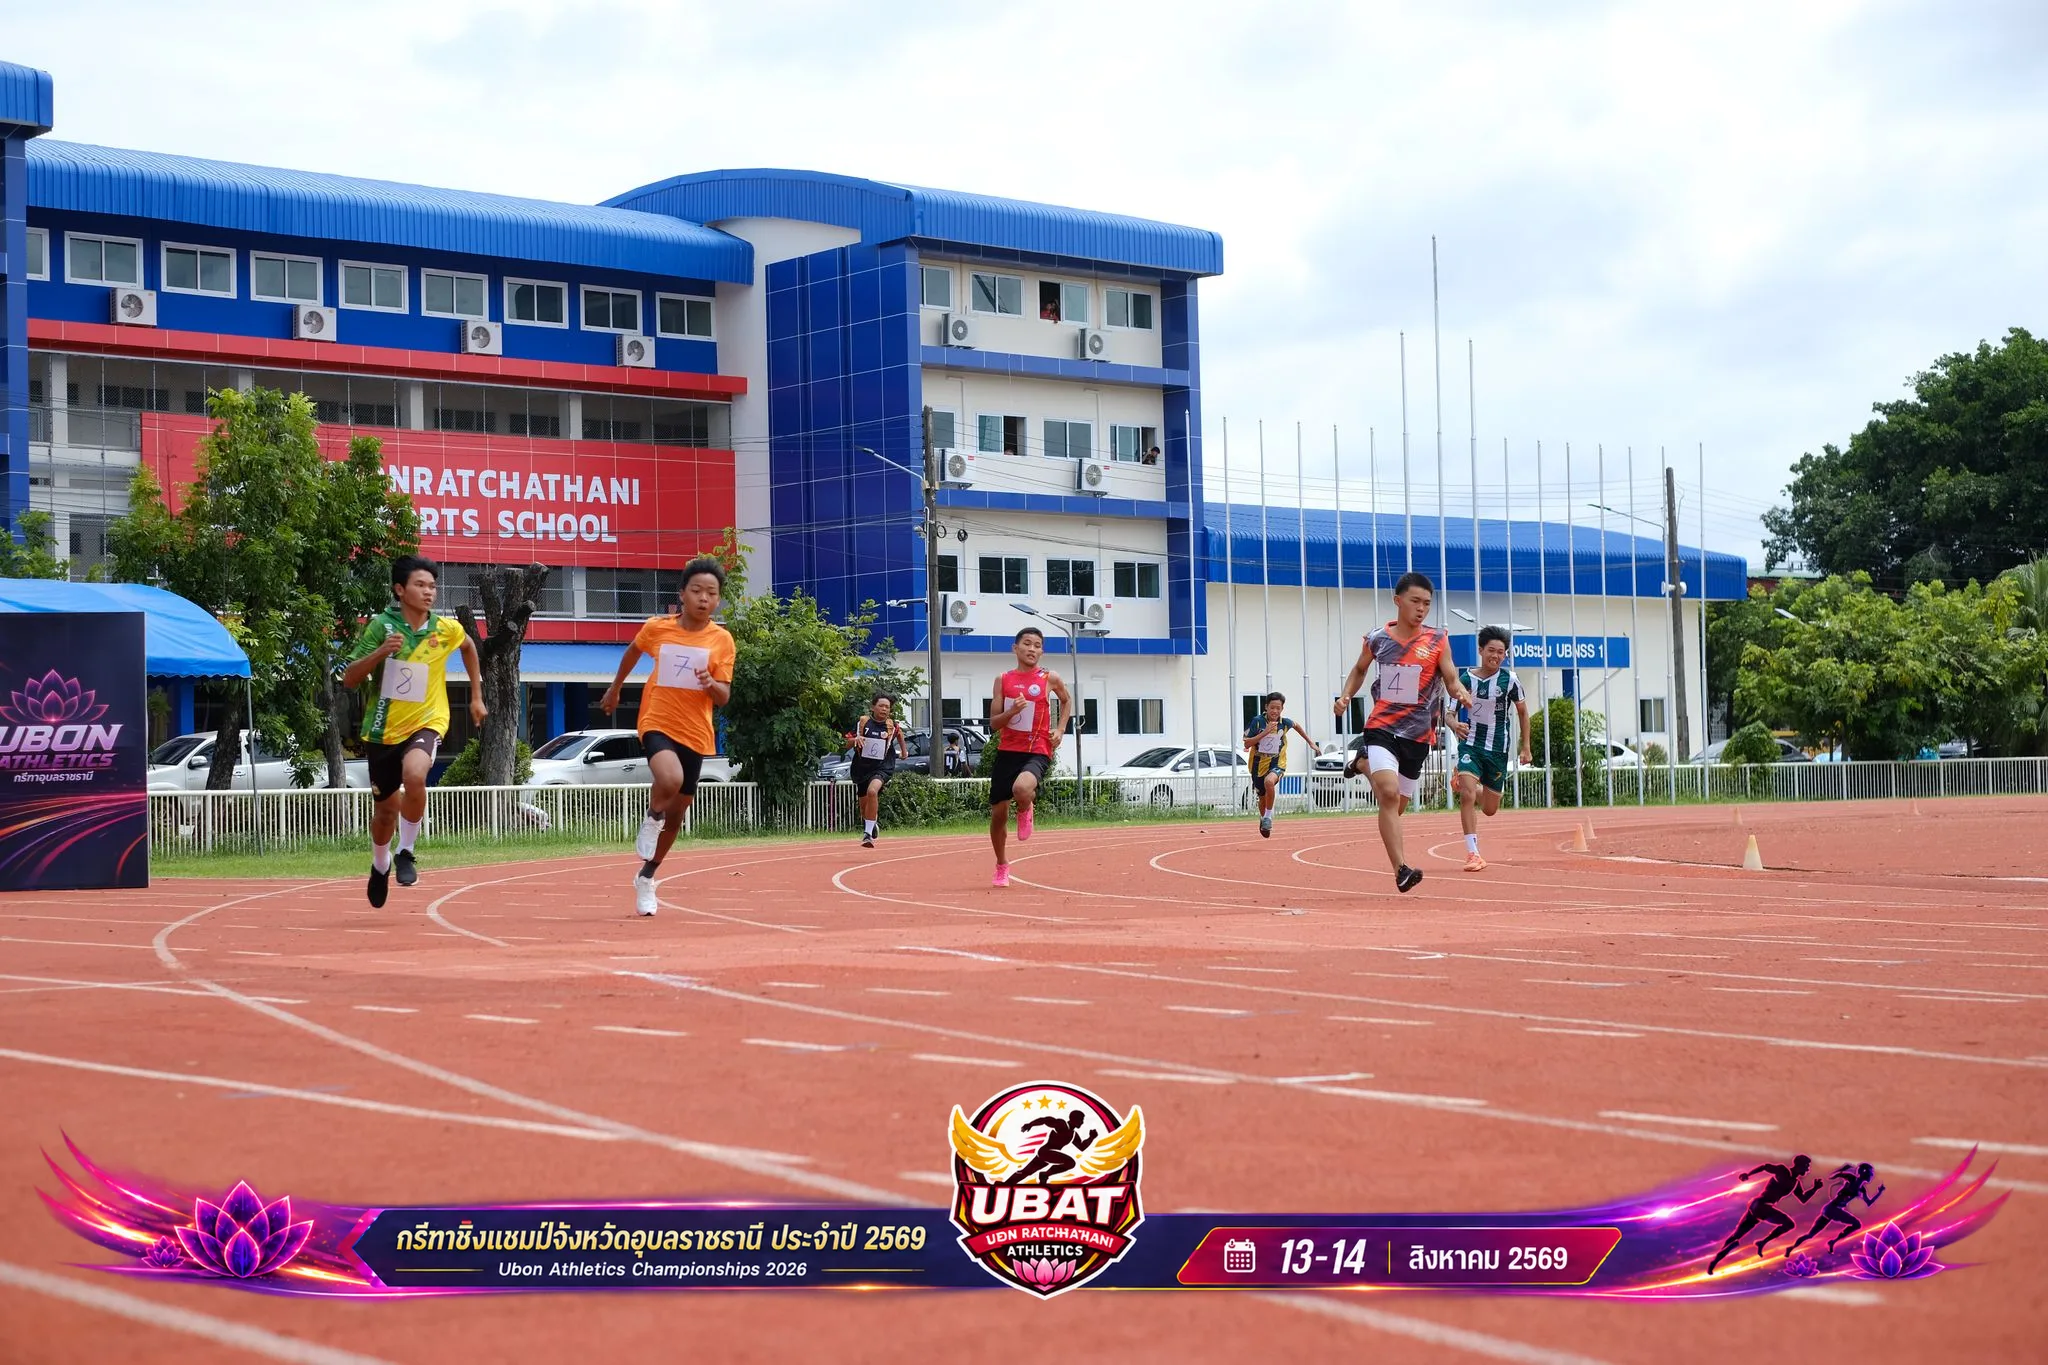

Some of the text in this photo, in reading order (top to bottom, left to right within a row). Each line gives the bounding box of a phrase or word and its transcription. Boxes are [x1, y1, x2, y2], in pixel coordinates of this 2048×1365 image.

[377, 464, 640, 505] NRATCHATHANI
[498, 510, 617, 543] SCHOOL
[674, 654, 693, 677] 7
[396, 667, 413, 694] 8
[1387, 672, 1404, 695] 4
[1472, 702, 1483, 717] 2
[0, 724, 124, 753] UBON
[864, 727, 870, 735] 7
[0, 753, 119, 769] ATHLETICS
[870, 742, 879, 757] 6
[945, 755, 954, 770] 4
